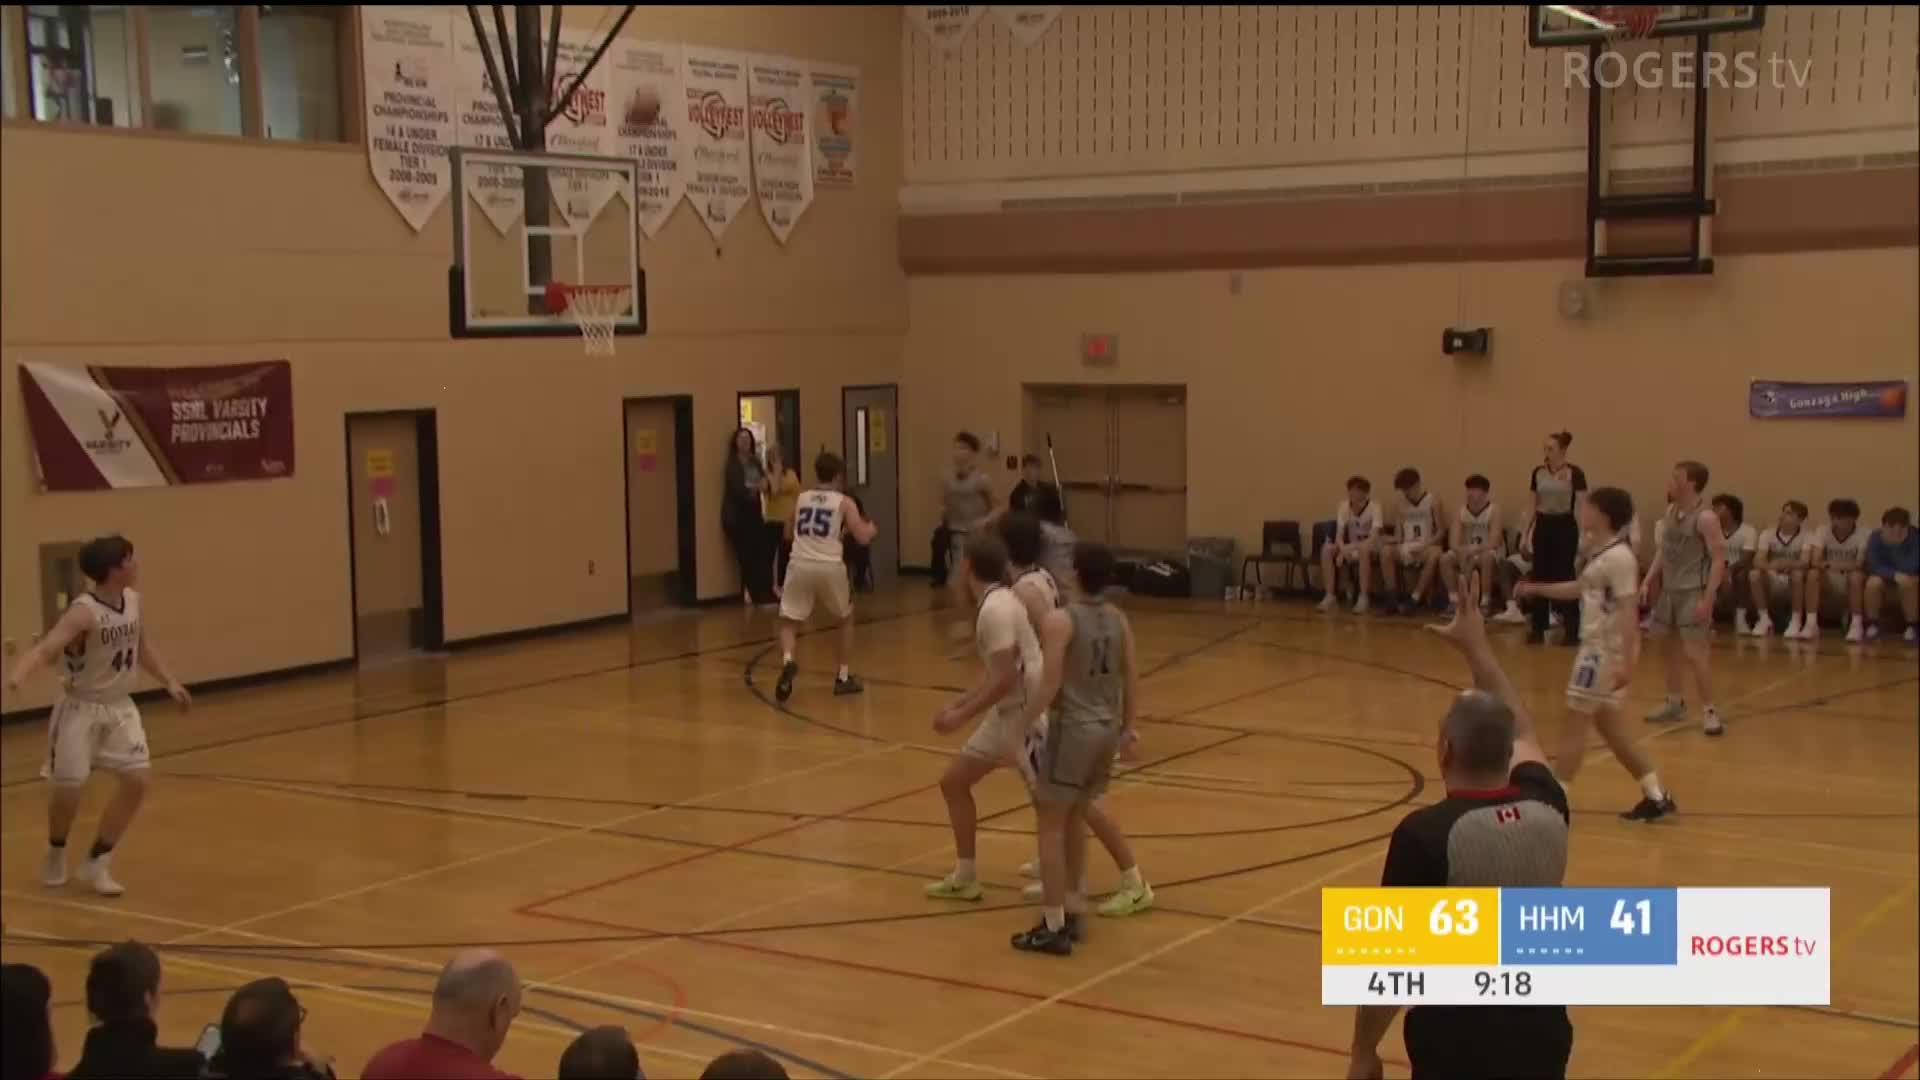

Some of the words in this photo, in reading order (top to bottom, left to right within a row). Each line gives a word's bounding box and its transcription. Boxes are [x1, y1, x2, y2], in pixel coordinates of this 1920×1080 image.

[383, 91, 437, 109] PROVINCIAL
[372, 103, 449, 124] CHAMPIONSHIPS
[407, 127, 438, 141] UNDER
[373, 136, 410, 154] FEMALE
[400, 154, 419, 169] TIER
[212, 397, 268, 419] VARSITY
[171, 420, 260, 444] PROVINCIALS
[798, 507, 832, 538] 25
[111, 647, 134, 672] 44
